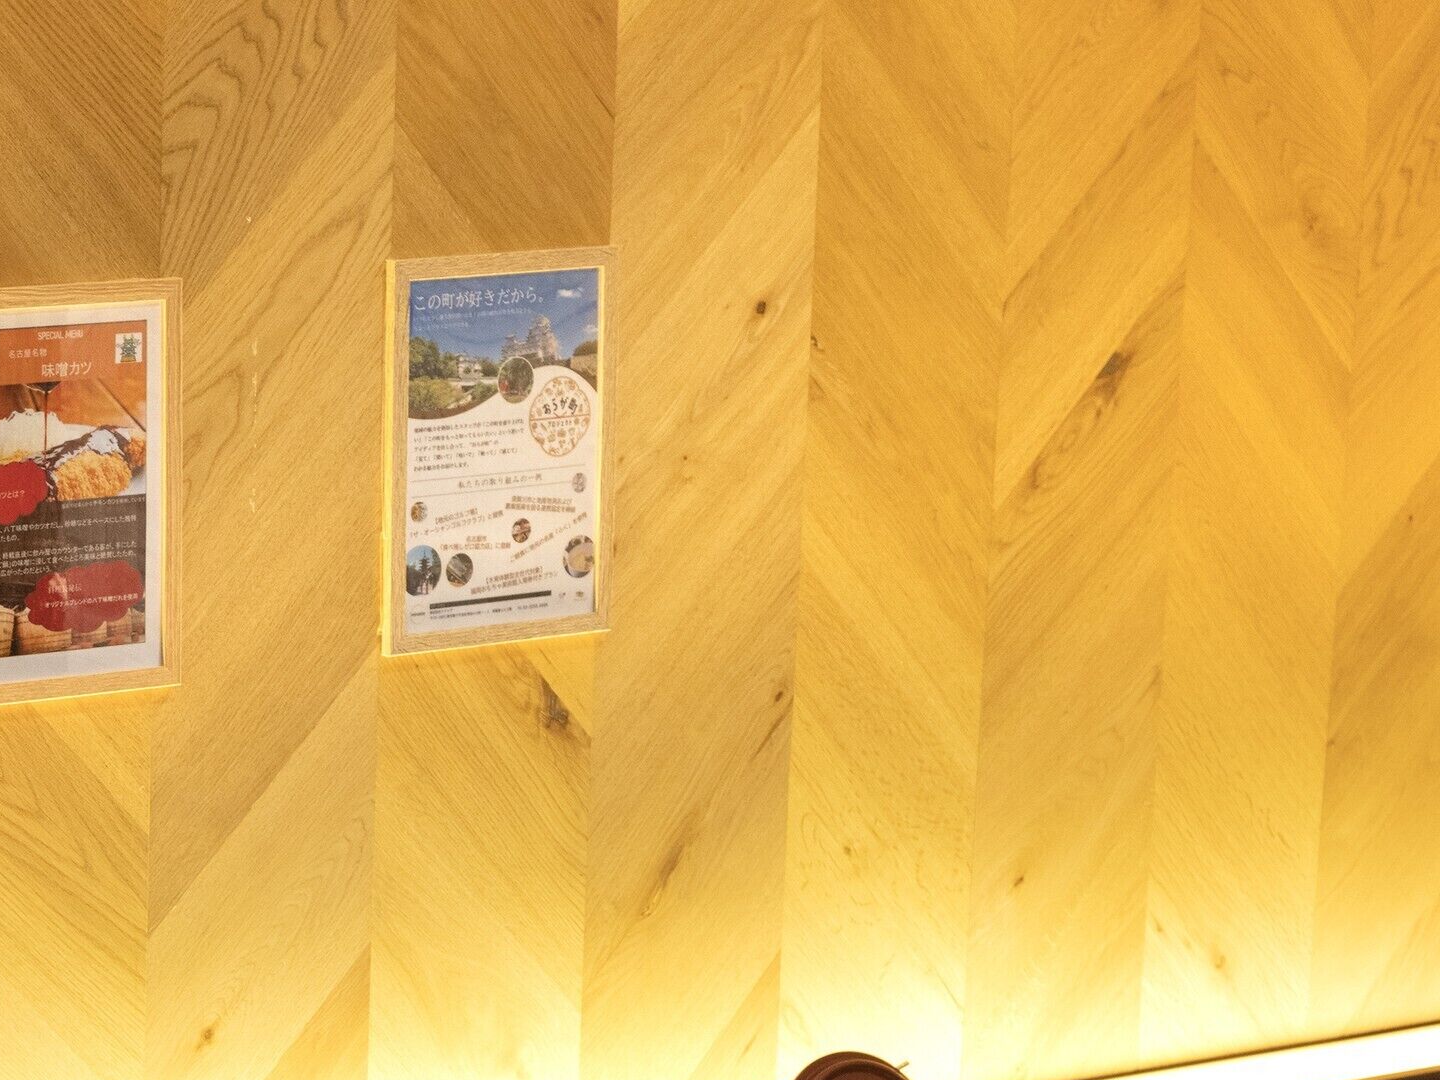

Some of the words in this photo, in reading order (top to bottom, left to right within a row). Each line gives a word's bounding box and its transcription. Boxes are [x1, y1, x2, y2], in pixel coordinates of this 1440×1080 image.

[414, 287, 544, 311] この町が好きだから。
[41, 361, 92, 377] 味噌カツ
